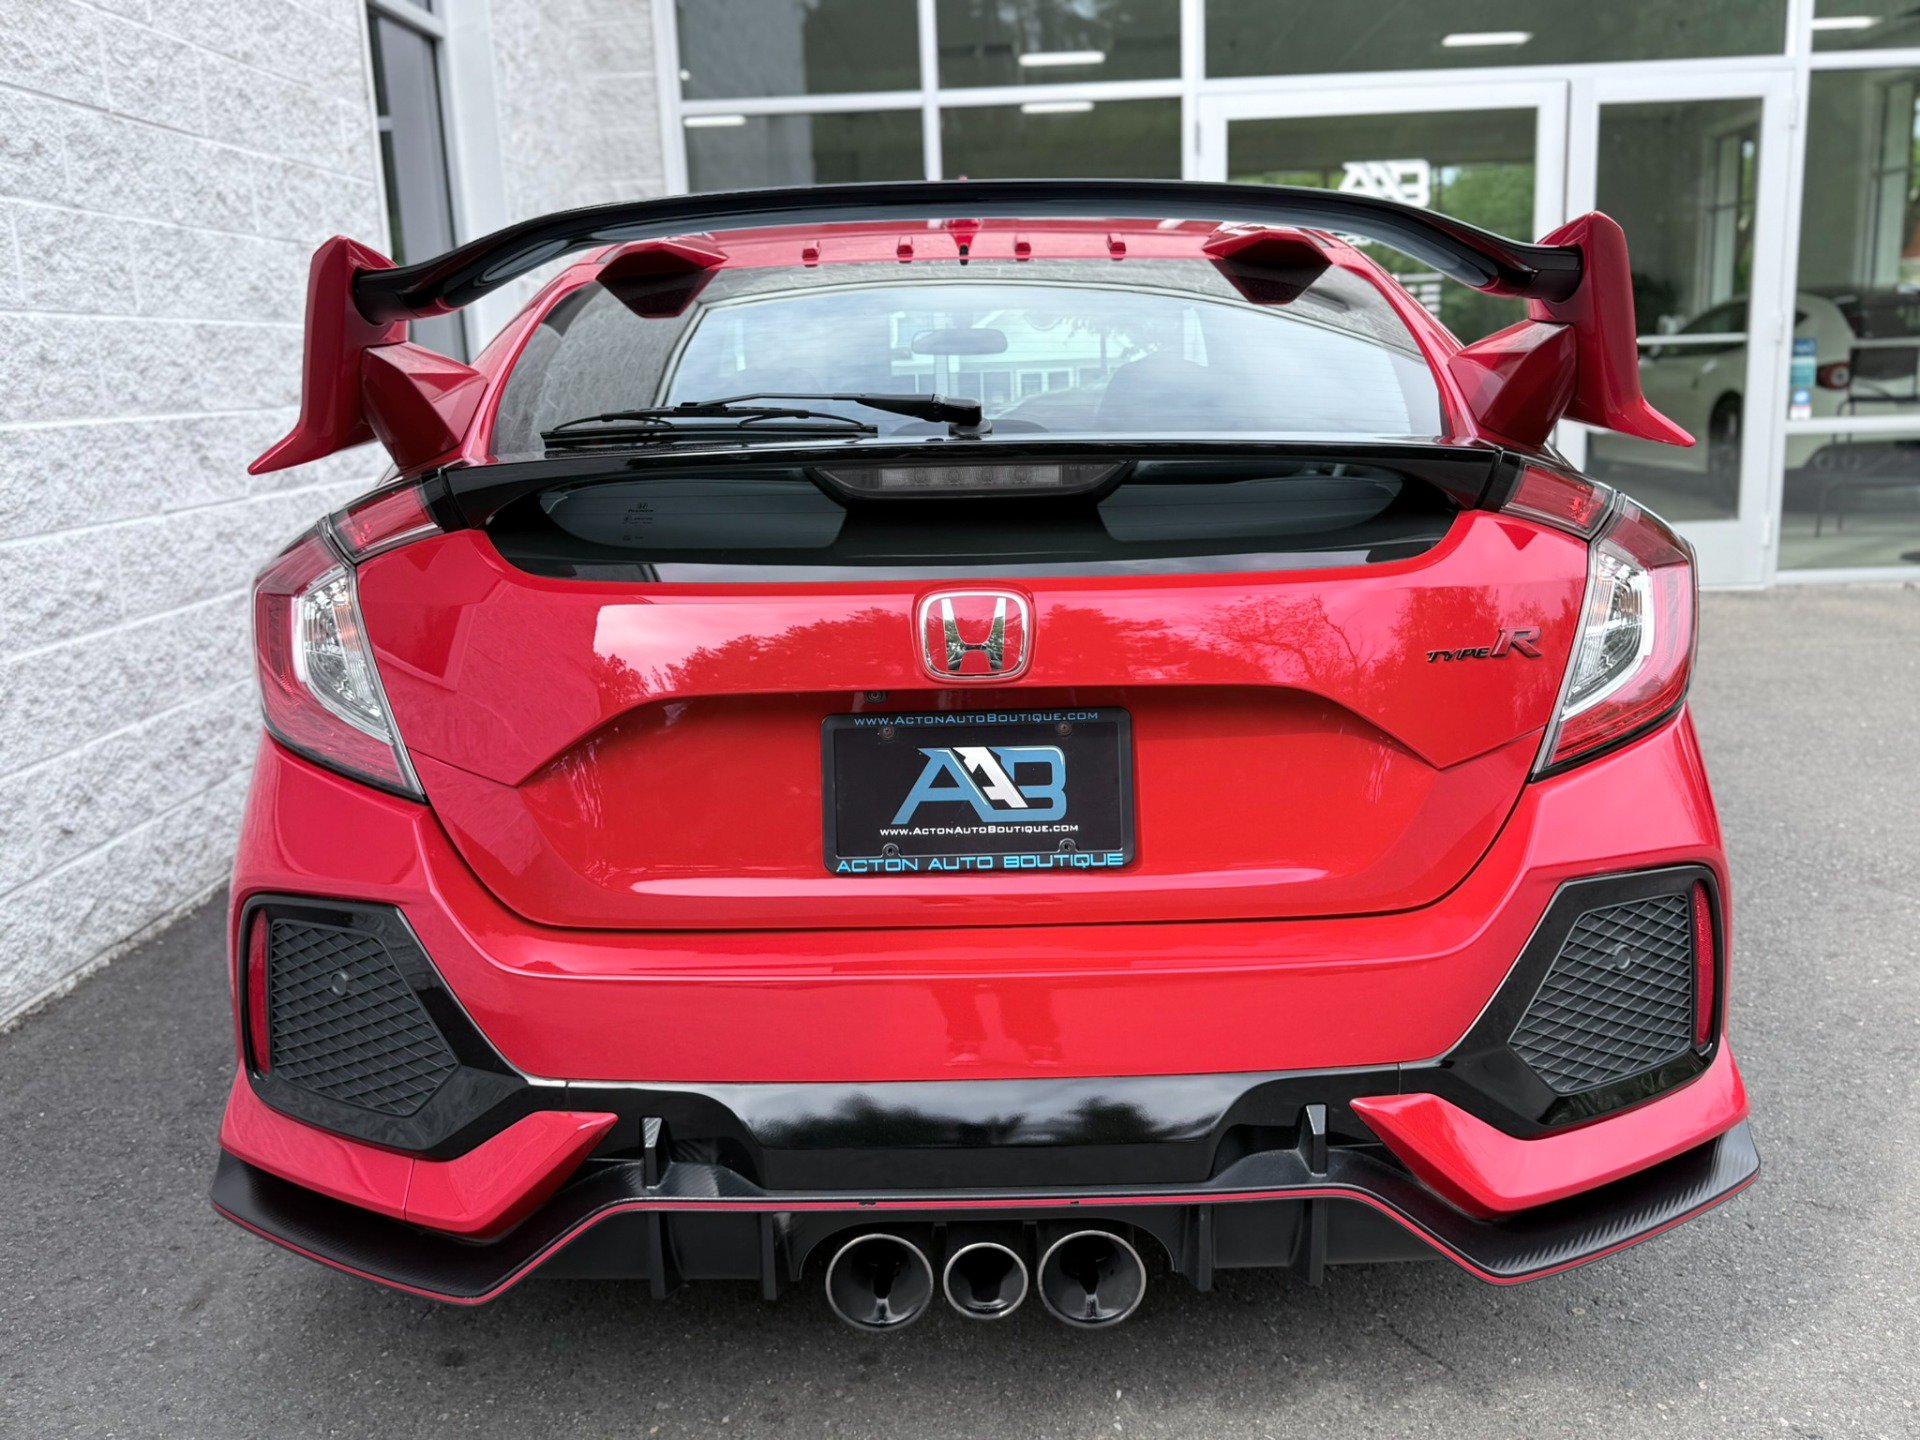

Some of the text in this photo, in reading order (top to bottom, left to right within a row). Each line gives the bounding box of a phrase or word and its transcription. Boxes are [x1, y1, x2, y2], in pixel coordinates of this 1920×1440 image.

[1426, 626, 1542, 663] TYPE R
[891, 745, 1067, 825] AAB
[836, 853, 1124, 873] ACTON AUTO BOUTIQUE
